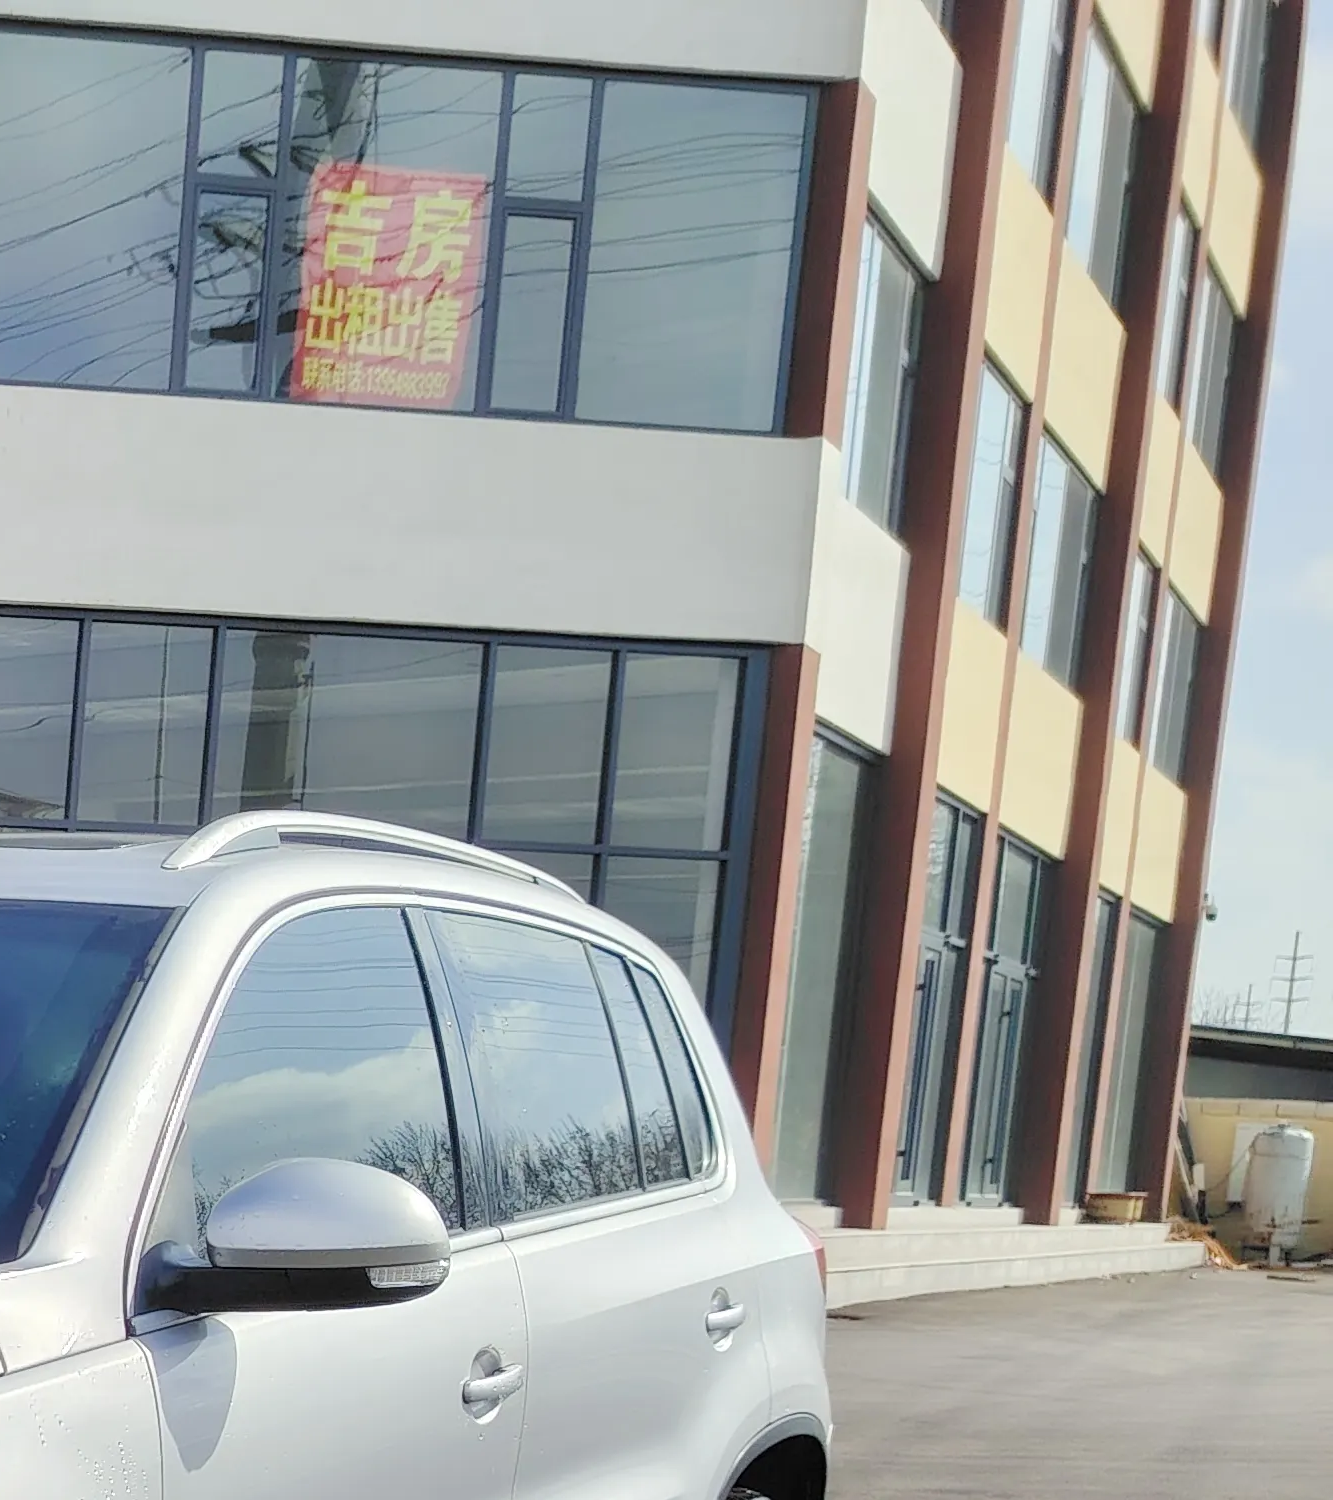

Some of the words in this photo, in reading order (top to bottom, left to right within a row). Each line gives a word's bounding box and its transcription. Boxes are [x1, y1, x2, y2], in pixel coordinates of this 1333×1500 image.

[321, 179, 474, 282] 吉房
[304, 277, 463, 365] 出租出售
